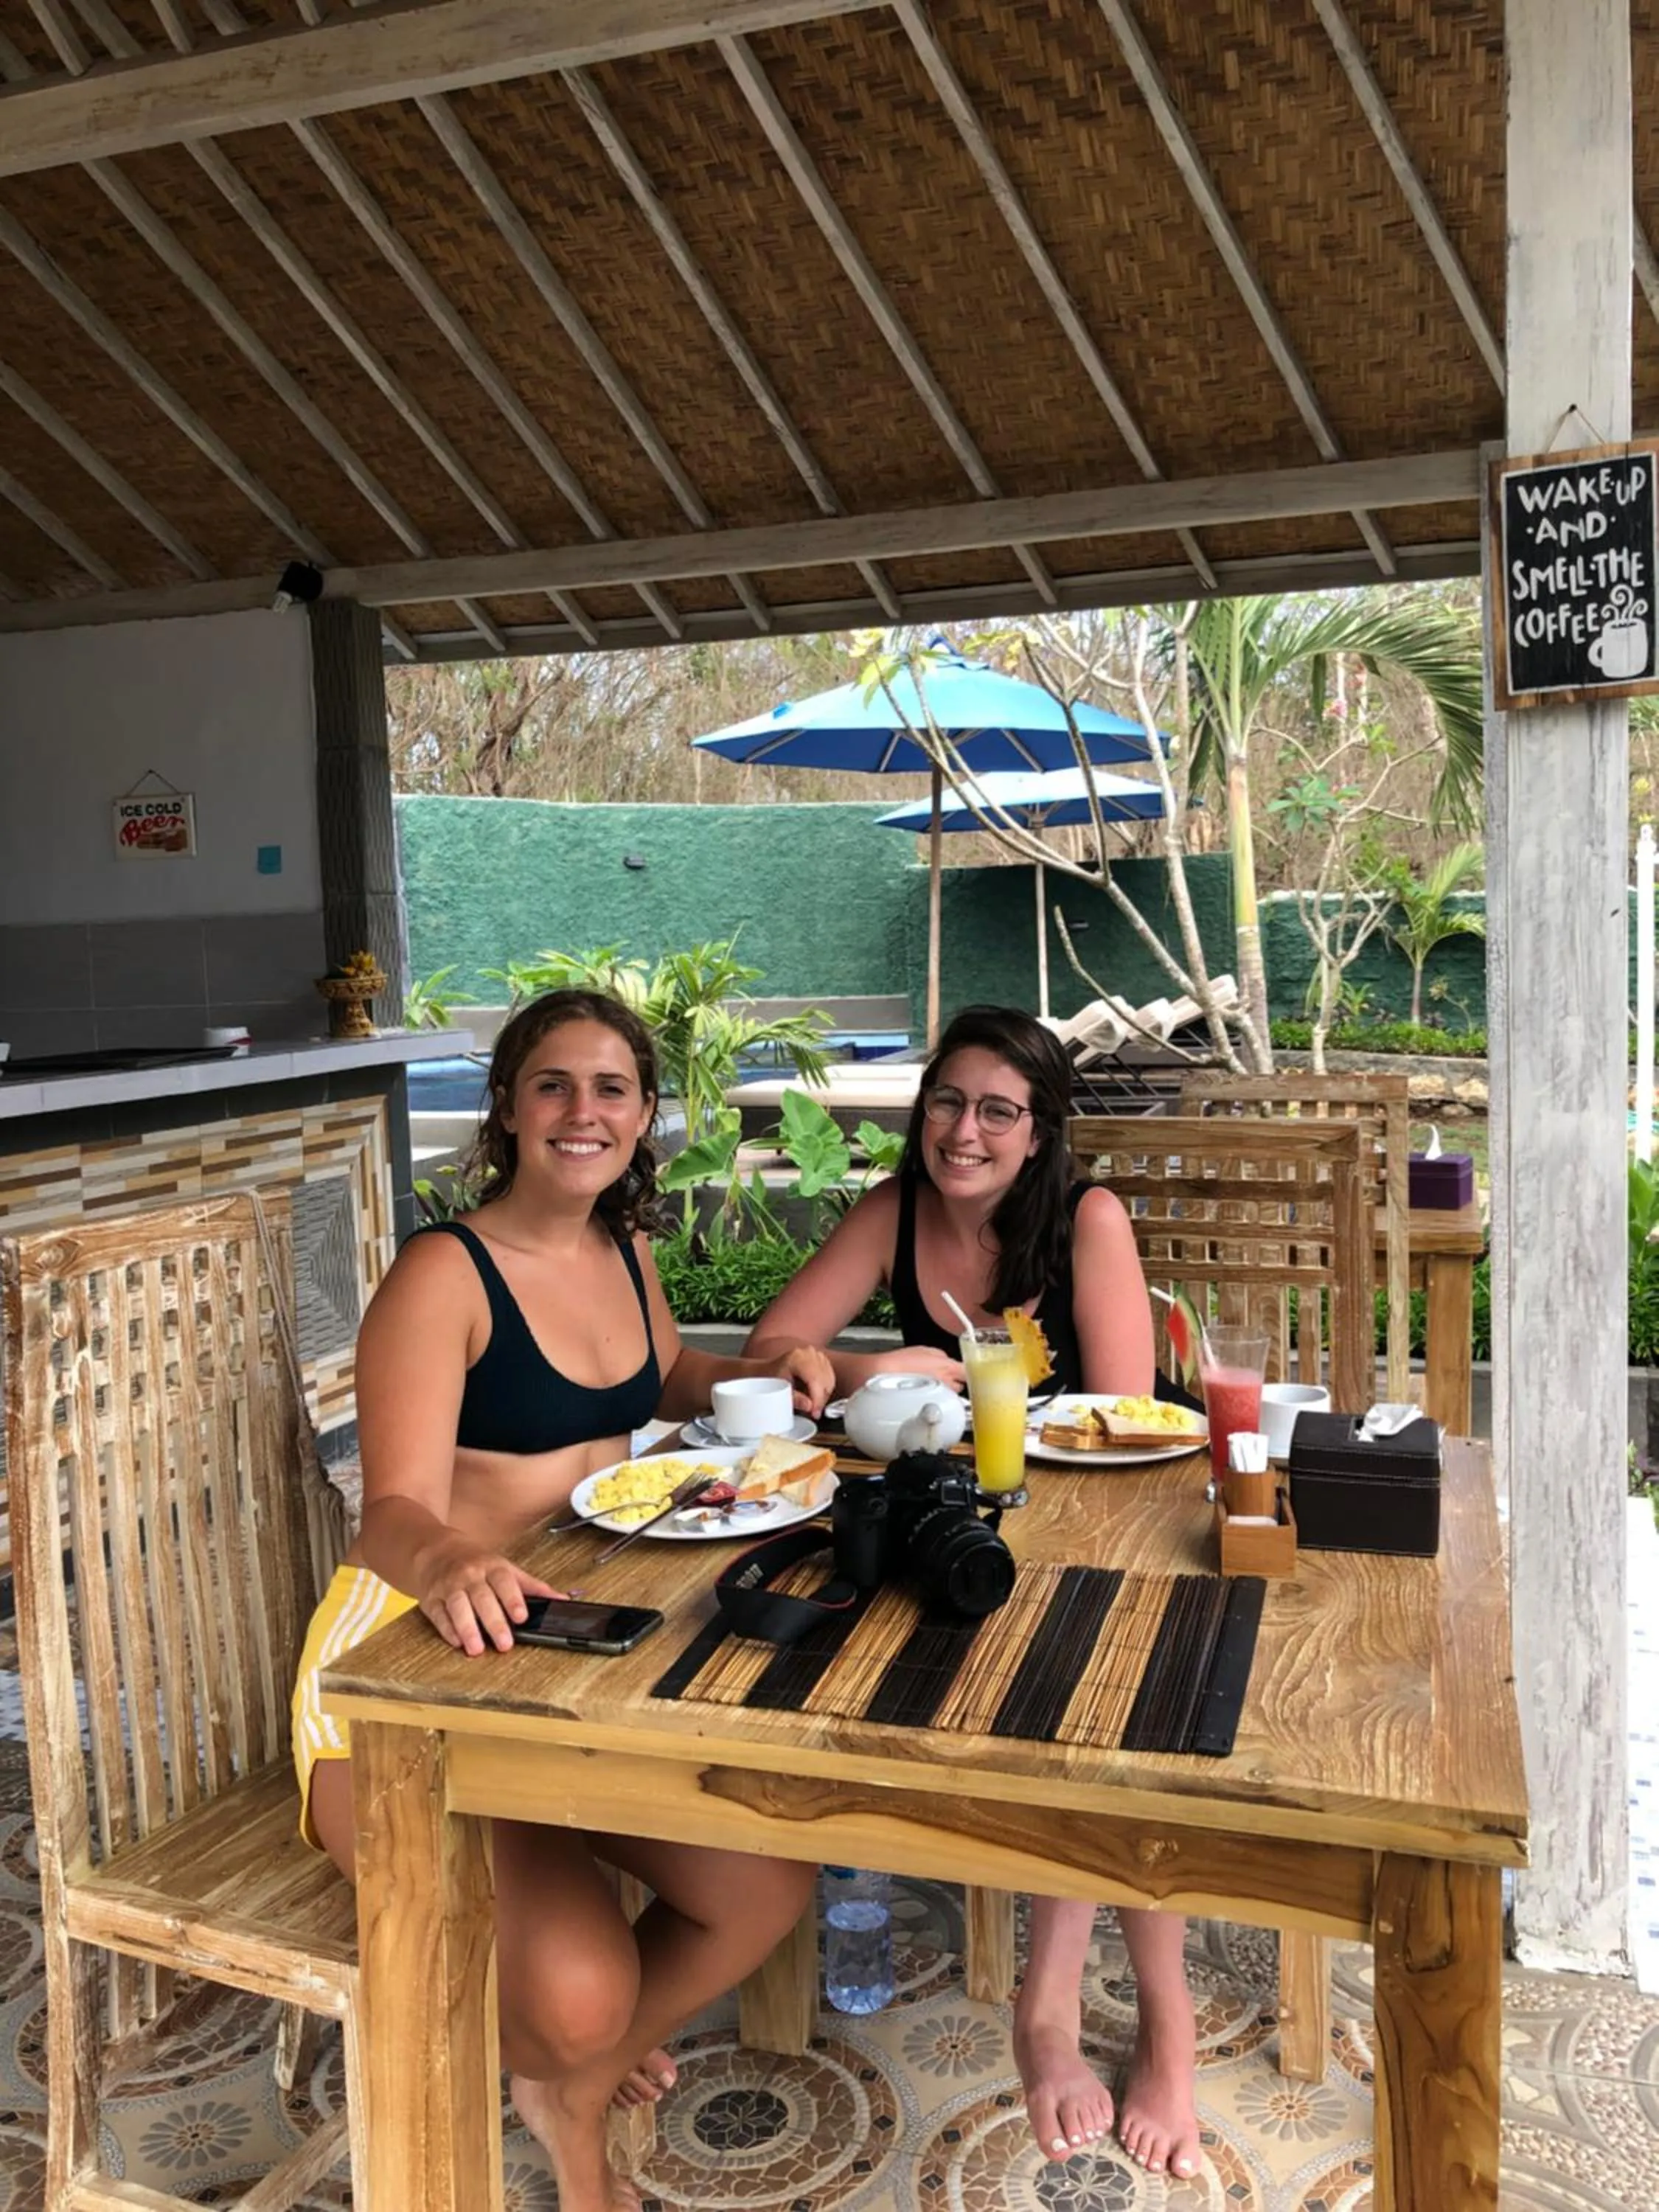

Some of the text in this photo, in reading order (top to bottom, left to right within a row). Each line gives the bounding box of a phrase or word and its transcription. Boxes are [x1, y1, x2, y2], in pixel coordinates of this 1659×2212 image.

[1616, 467, 1646, 505] UP
[1594, 546, 1645, 588] THE
[1514, 603, 1600, 647] COFFEE
[121, 803, 181, 816] ICE COLD
[120, 815, 185, 846] Beer
